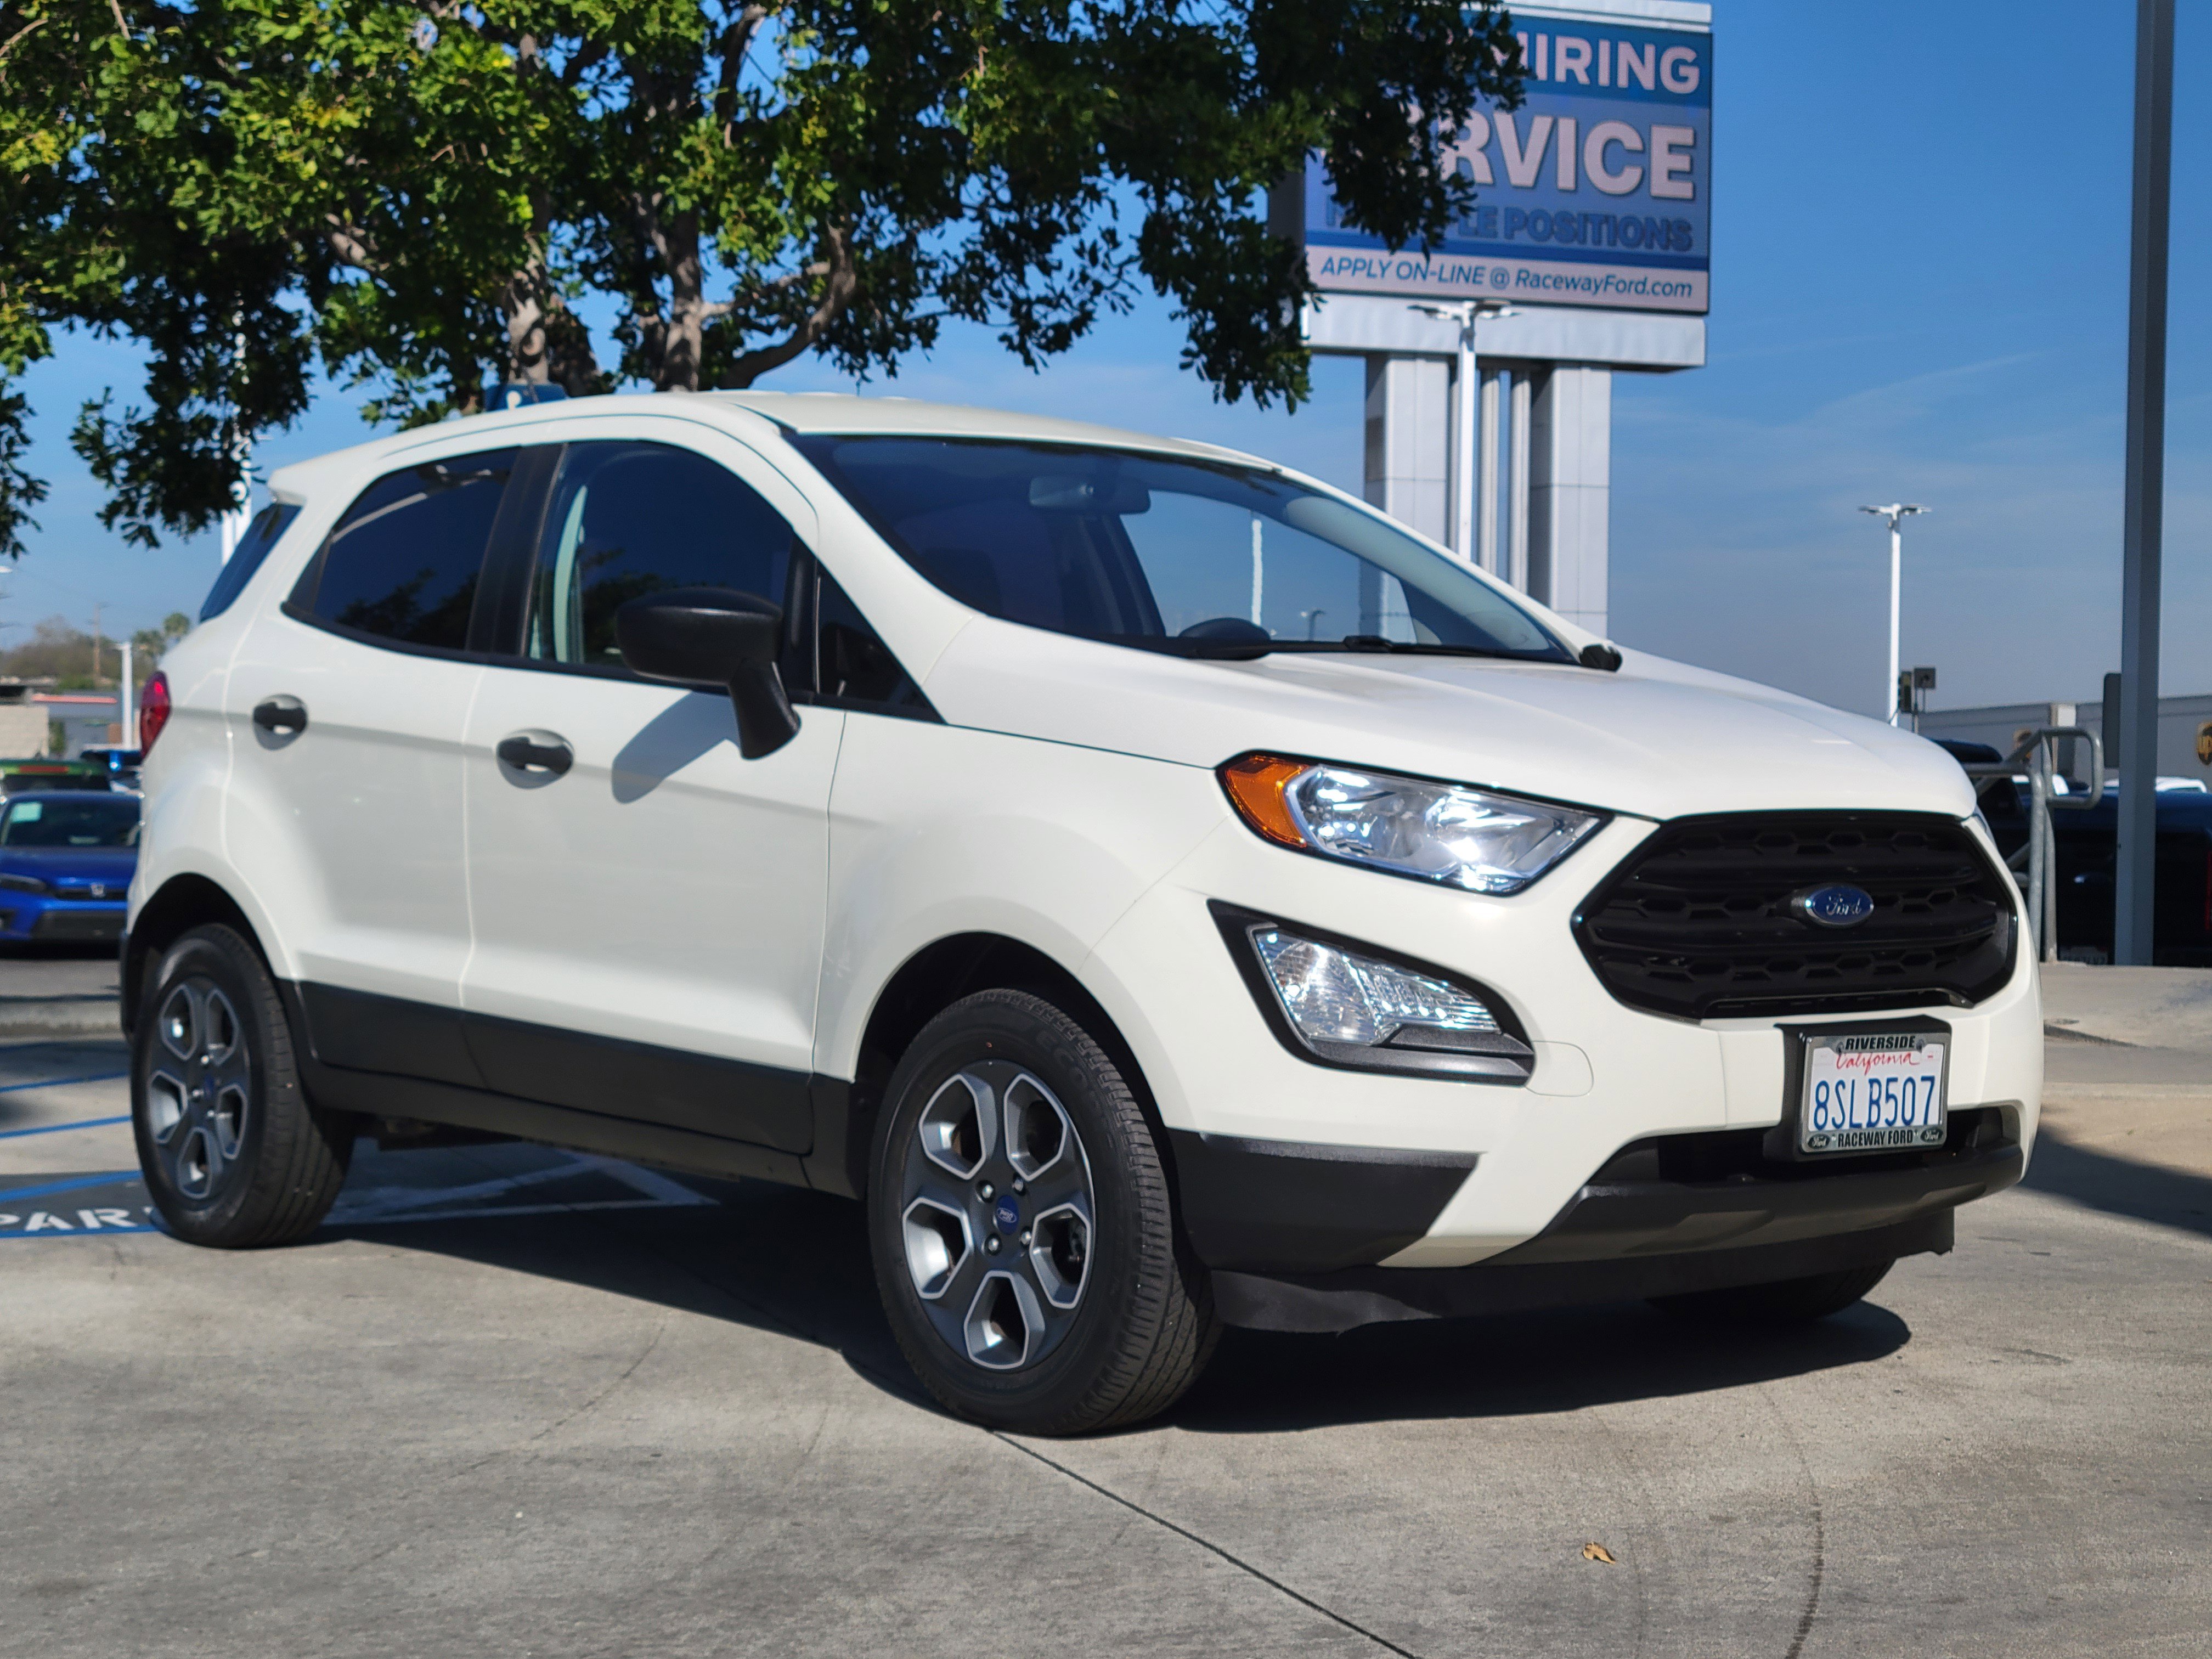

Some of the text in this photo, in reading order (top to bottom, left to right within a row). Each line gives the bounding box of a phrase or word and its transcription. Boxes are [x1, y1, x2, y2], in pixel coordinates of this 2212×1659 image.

[1402, 109, 1696, 199] RVICE
[1504, 206, 1693, 252] POSITIONS
[1321, 256, 1692, 297] APPLY ON-LINE @ RacewayFord.com
[1826, 894, 1862, 916] Ford
[1845, 1035, 1916, 1050] RIVERSIDE
[1836, 1053, 1920, 1075] California
[1813, 1075, 1936, 1131] 8SLB507
[1838, 1129, 1914, 1148] RACEWAY FORD
